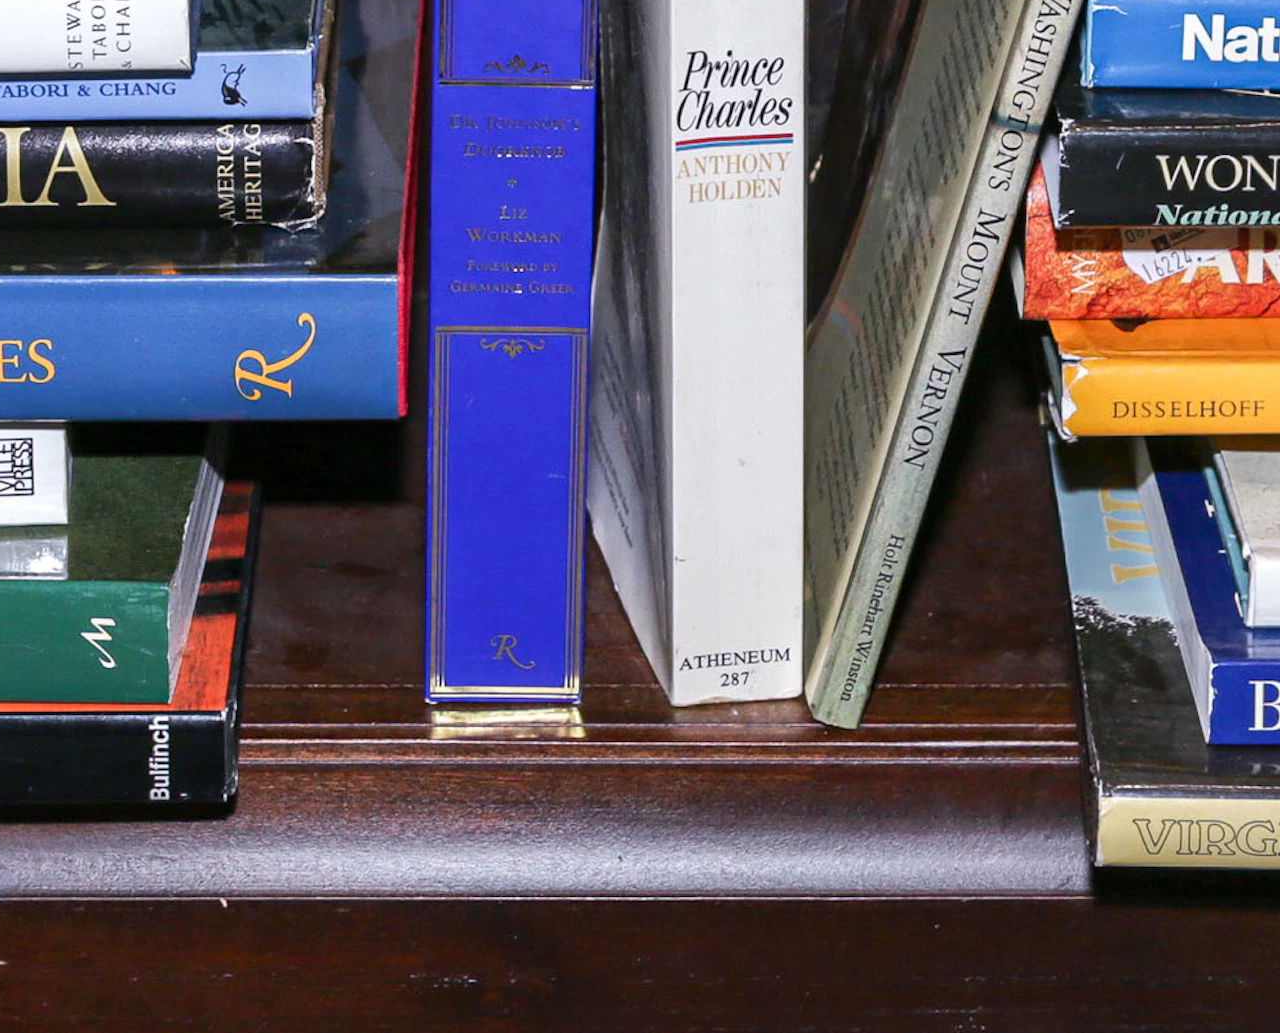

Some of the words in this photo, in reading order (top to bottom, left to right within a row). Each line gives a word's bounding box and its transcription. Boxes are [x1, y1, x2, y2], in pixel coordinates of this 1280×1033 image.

[679, 50, 784, 92] Prince
[676, 89, 792, 131] Charles
[678, 152, 792, 179] ANTHONY
[689, 178, 782, 204] HOLDEN
[949, 208, 1007, 324] MOUNT
[904, 347, 968, 469] VERNON
[1113, 399, 1266, 419] DISSELHOFF
[883, 534, 905, 568] Holt
[861, 571, 893, 636] Rinehart
[679, 648, 791, 671] ATHENEUM
[720, 672, 749, 687] 287
[840, 640, 874, 702] Winston
[148, 716, 170, 800] Bulfinch
